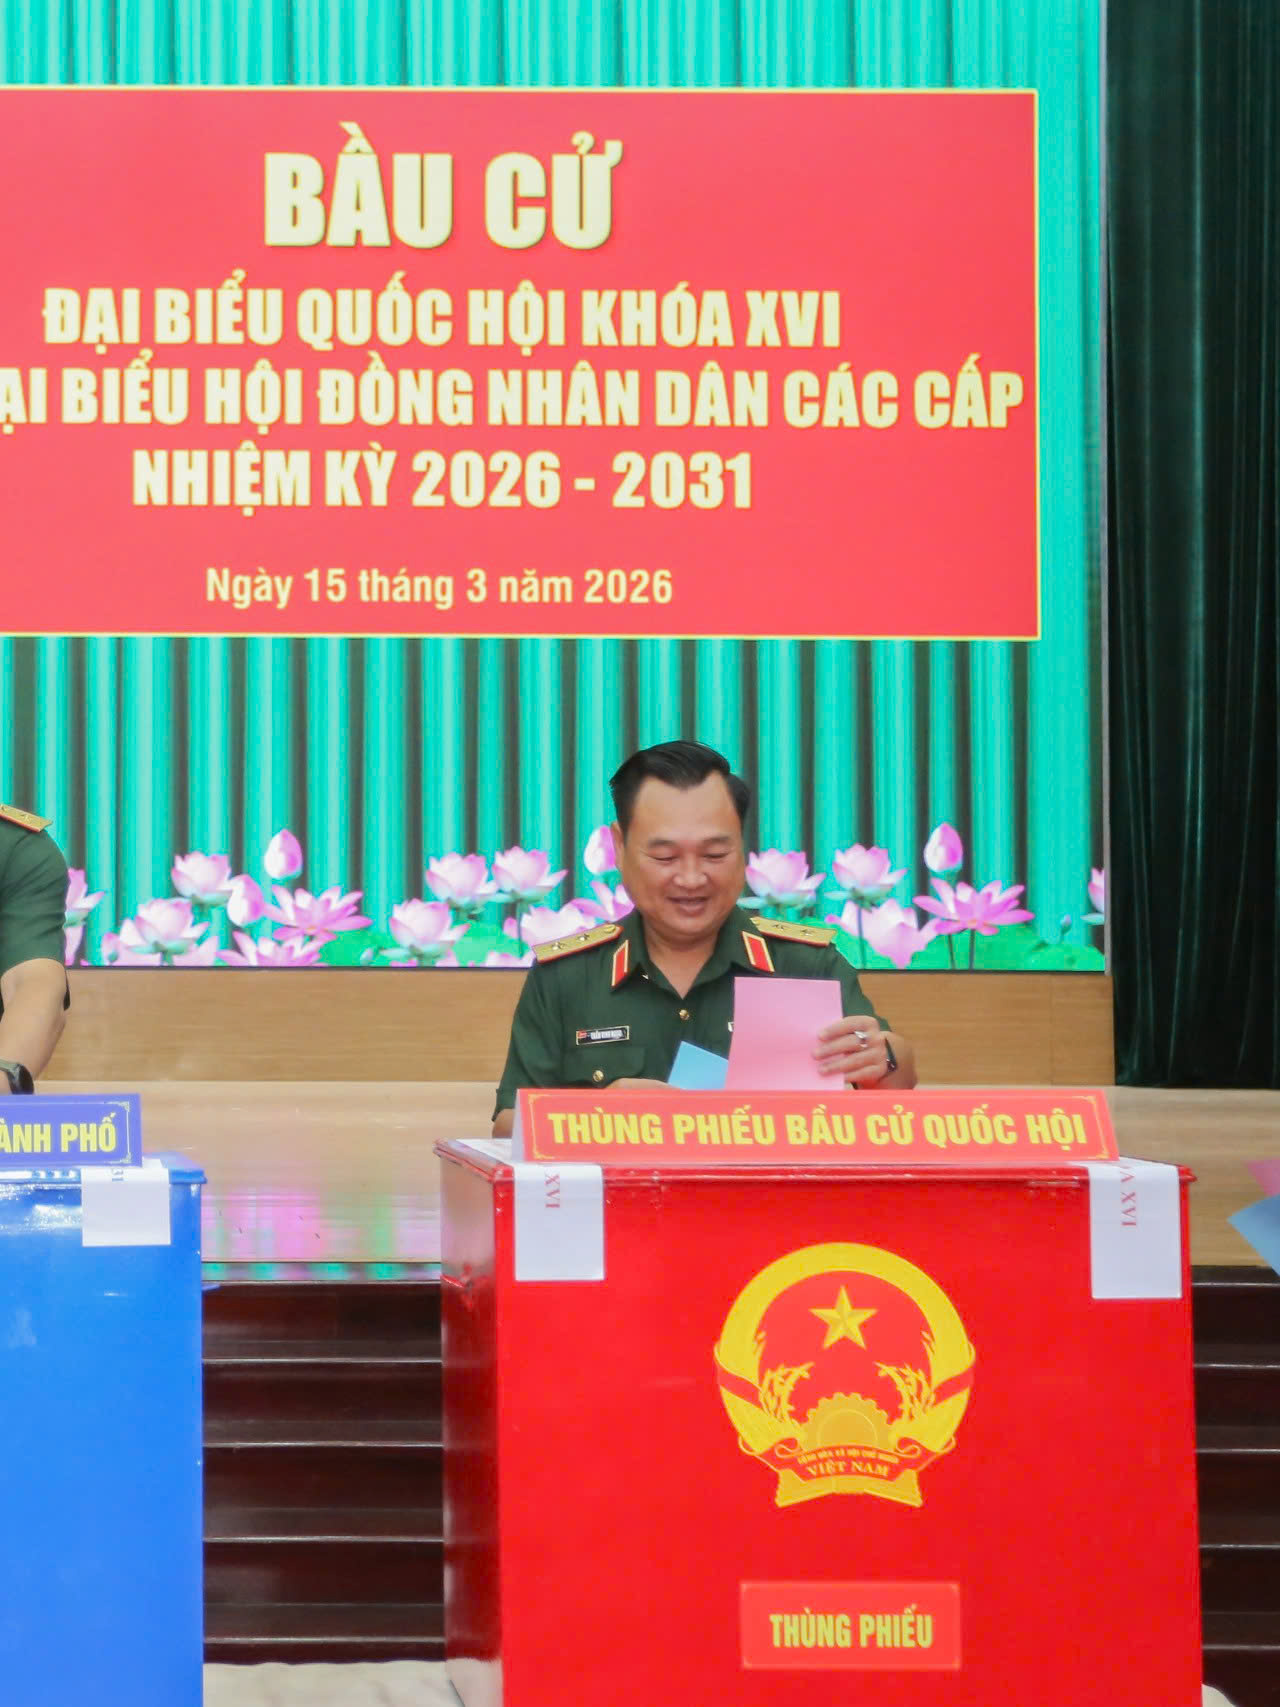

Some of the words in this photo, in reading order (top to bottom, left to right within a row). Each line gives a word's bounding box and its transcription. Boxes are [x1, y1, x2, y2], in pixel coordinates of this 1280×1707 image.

[264, 121, 453, 248] BẦU
[485, 130, 623, 249] CỬ
[42, 287, 140, 355] ĐẠI
[154, 268, 283, 346] BIỂU
[297, 270, 453, 352] QUỐC
[468, 279, 565, 356] HỘI
[581, 281, 734, 348] KHÓA
[746, 290, 840, 348] XVI
[61, 347, 189, 425] BIỂU
[204, 358, 303, 435] HỘI
[317, 350, 474, 427] ĐỒNG
[487, 360, 640, 427] NHÂN
[655, 360, 769, 428] DÂN
[783, 362, 899, 429] CÁC
[914, 353, 1024, 430] CẤP
[133, 439, 311, 517] NHIỆM
[325, 441, 397, 507] KỲ
[412, 451, 561, 508] 2026
[574, 477, 596, 491] -
[612, 451, 751, 509] 2031
[207, 567, 293, 610] Ngày
[304, 567, 347, 603] 15
[358, 567, 454, 610] tháng
[466, 568, 487, 603] 3
[499, 569, 573, 604] năm
[584, 568, 673, 605] 2026
[61, 1114, 117, 1152] PHỐ
[547, 1105, 663, 1145] THÙNG
[673, 1104, 776, 1146] PHIẾU
[786, 1104, 856, 1146] BẦU
[867, 1105, 915, 1146] CỬ
[924, 1104, 1017, 1147] QUỐC
[1025, 1108, 1087, 1151] HỘI
[544, 1174, 560, 1208] XVI
[1121, 1191, 1136, 1226] XVI
[805, 1460, 846, 1476] VIỆT
[852, 1461, 889, 1476] NAM
[769, 1607, 851, 1649] THÙNG
[860, 1603, 933, 1649] PHIẾU
